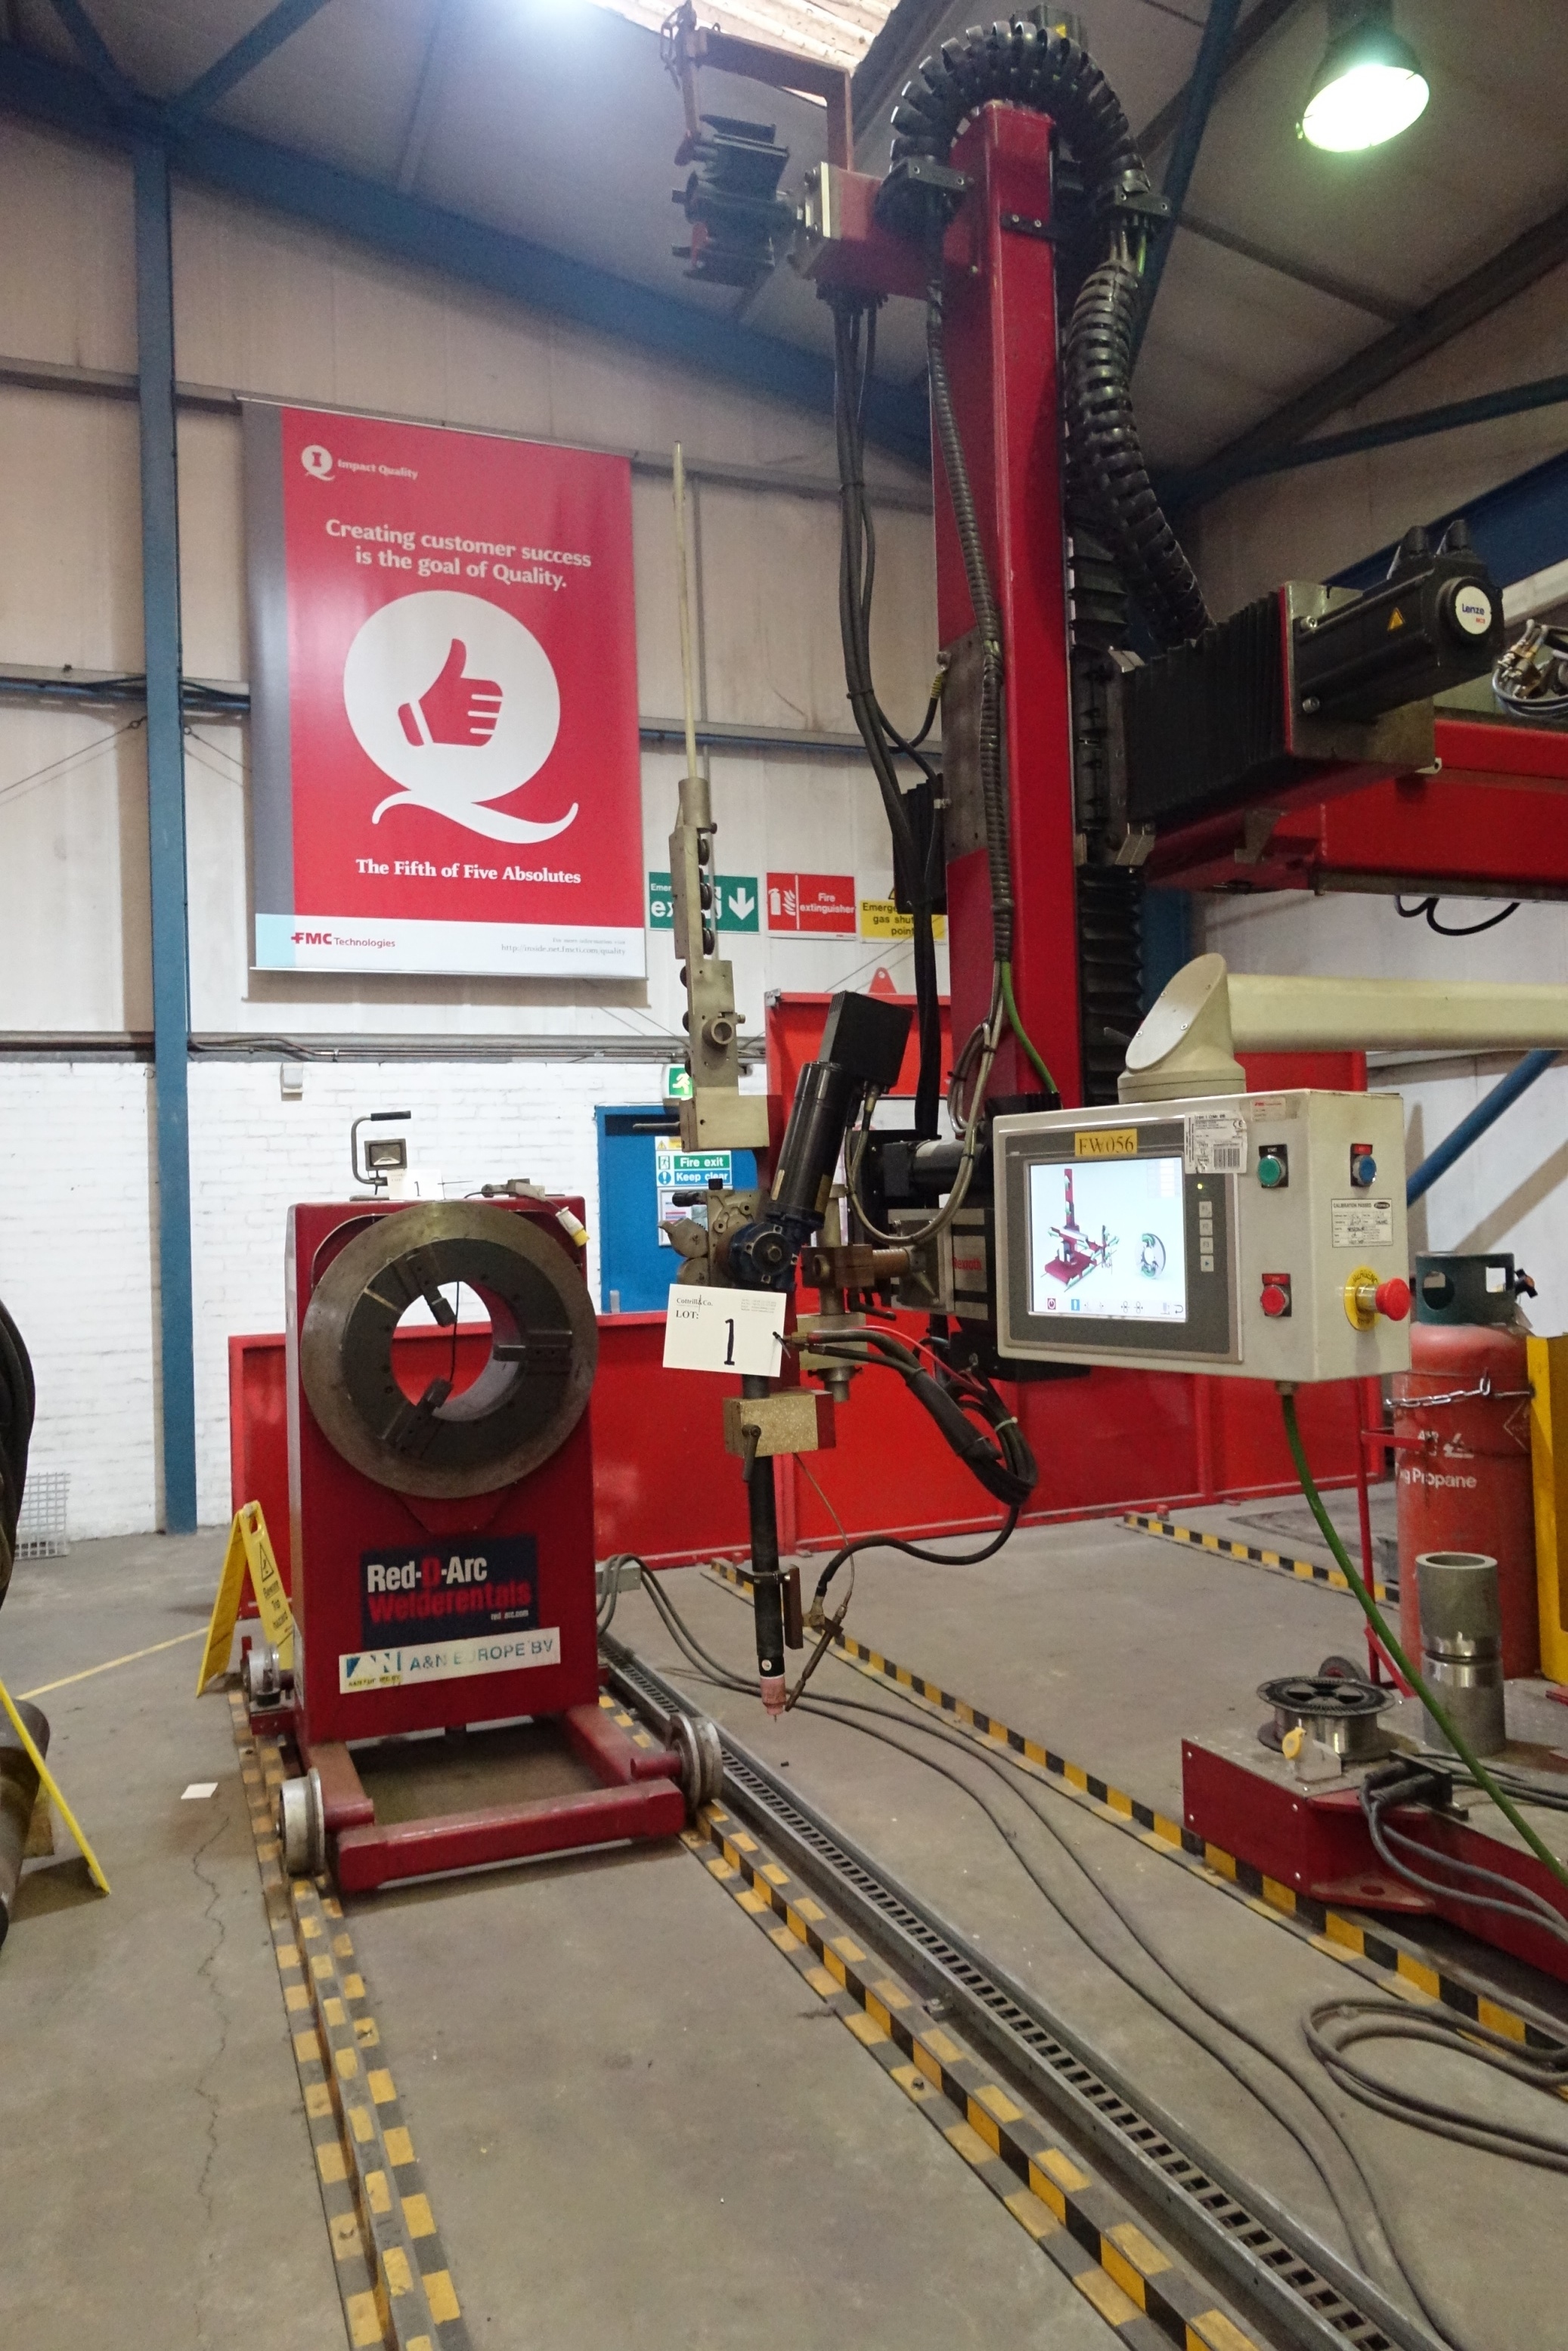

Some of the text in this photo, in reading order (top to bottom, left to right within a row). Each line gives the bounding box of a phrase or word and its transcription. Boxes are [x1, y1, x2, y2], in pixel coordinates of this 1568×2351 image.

[337, 459, 418, 480] Impact Quality
[325, 519, 592, 567] Creating customer success
[355, 545, 567, 591] is the goal of Quality.
[1461, 603, 1485, 615] Lenze
[355, 859, 581, 884] The Fifth of Five Absolutes
[818, 893, 836, 903] Fire
[799, 903, 855, 915] extinguisher
[873, 915, 890, 925] gas
[291, 932, 395, 949] FMC Technologies
[1079, 1135, 1134, 1155] FW056
[680, 1157, 724, 1168] Fire exit
[676, 1172, 728, 1182] Keep clear
[414, 1181, 421, 1197] 1
[676, 1309, 699, 1320] LOT:
[724, 1318, 735, 1366] 1
[1412, 1467, 1477, 1489] Propane
[367, 1556, 488, 1593] Red-D-Arc
[368, 1578, 531, 1623] Welderentals
[454, 1643, 525, 1665] EROPE
[531, 1639, 553, 1654] BV
